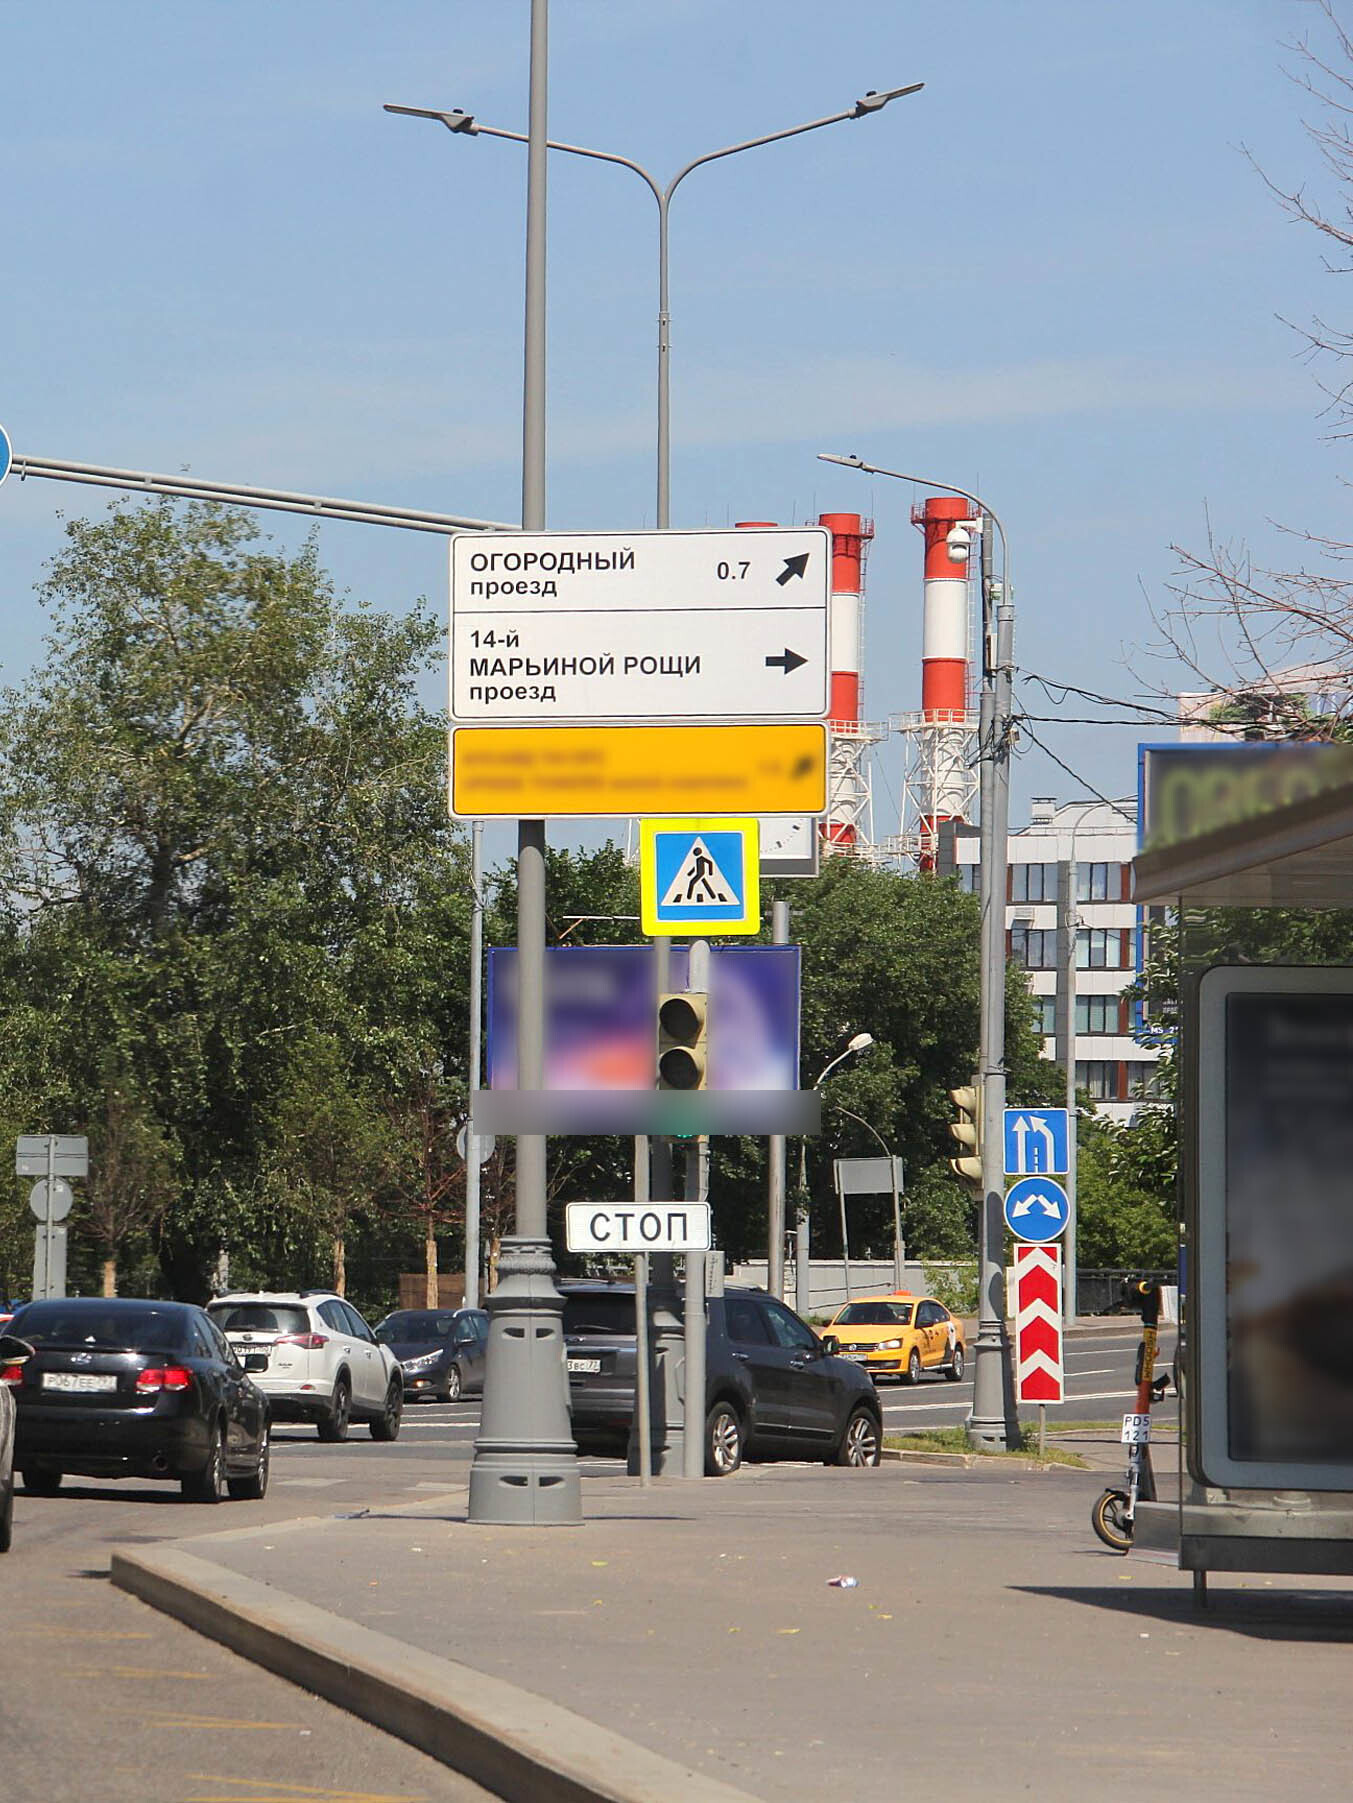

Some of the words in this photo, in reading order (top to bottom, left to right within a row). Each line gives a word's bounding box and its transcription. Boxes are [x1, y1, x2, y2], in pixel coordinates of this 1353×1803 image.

[470, 546, 636, 574] ОГОРОДНЫЙ
[717, 561, 751, 580] 0.7
[470, 580, 558, 600] проезд
[469, 629, 520, 648] 14-й
[469, 653, 615, 677] МАРЬИНОЙ
[623, 655, 701, 677] РОЩИ
[469, 685, 557, 705] проезд
[590, 1212, 688, 1242] СТОП
[1124, 1430, 1148, 1441] 121
